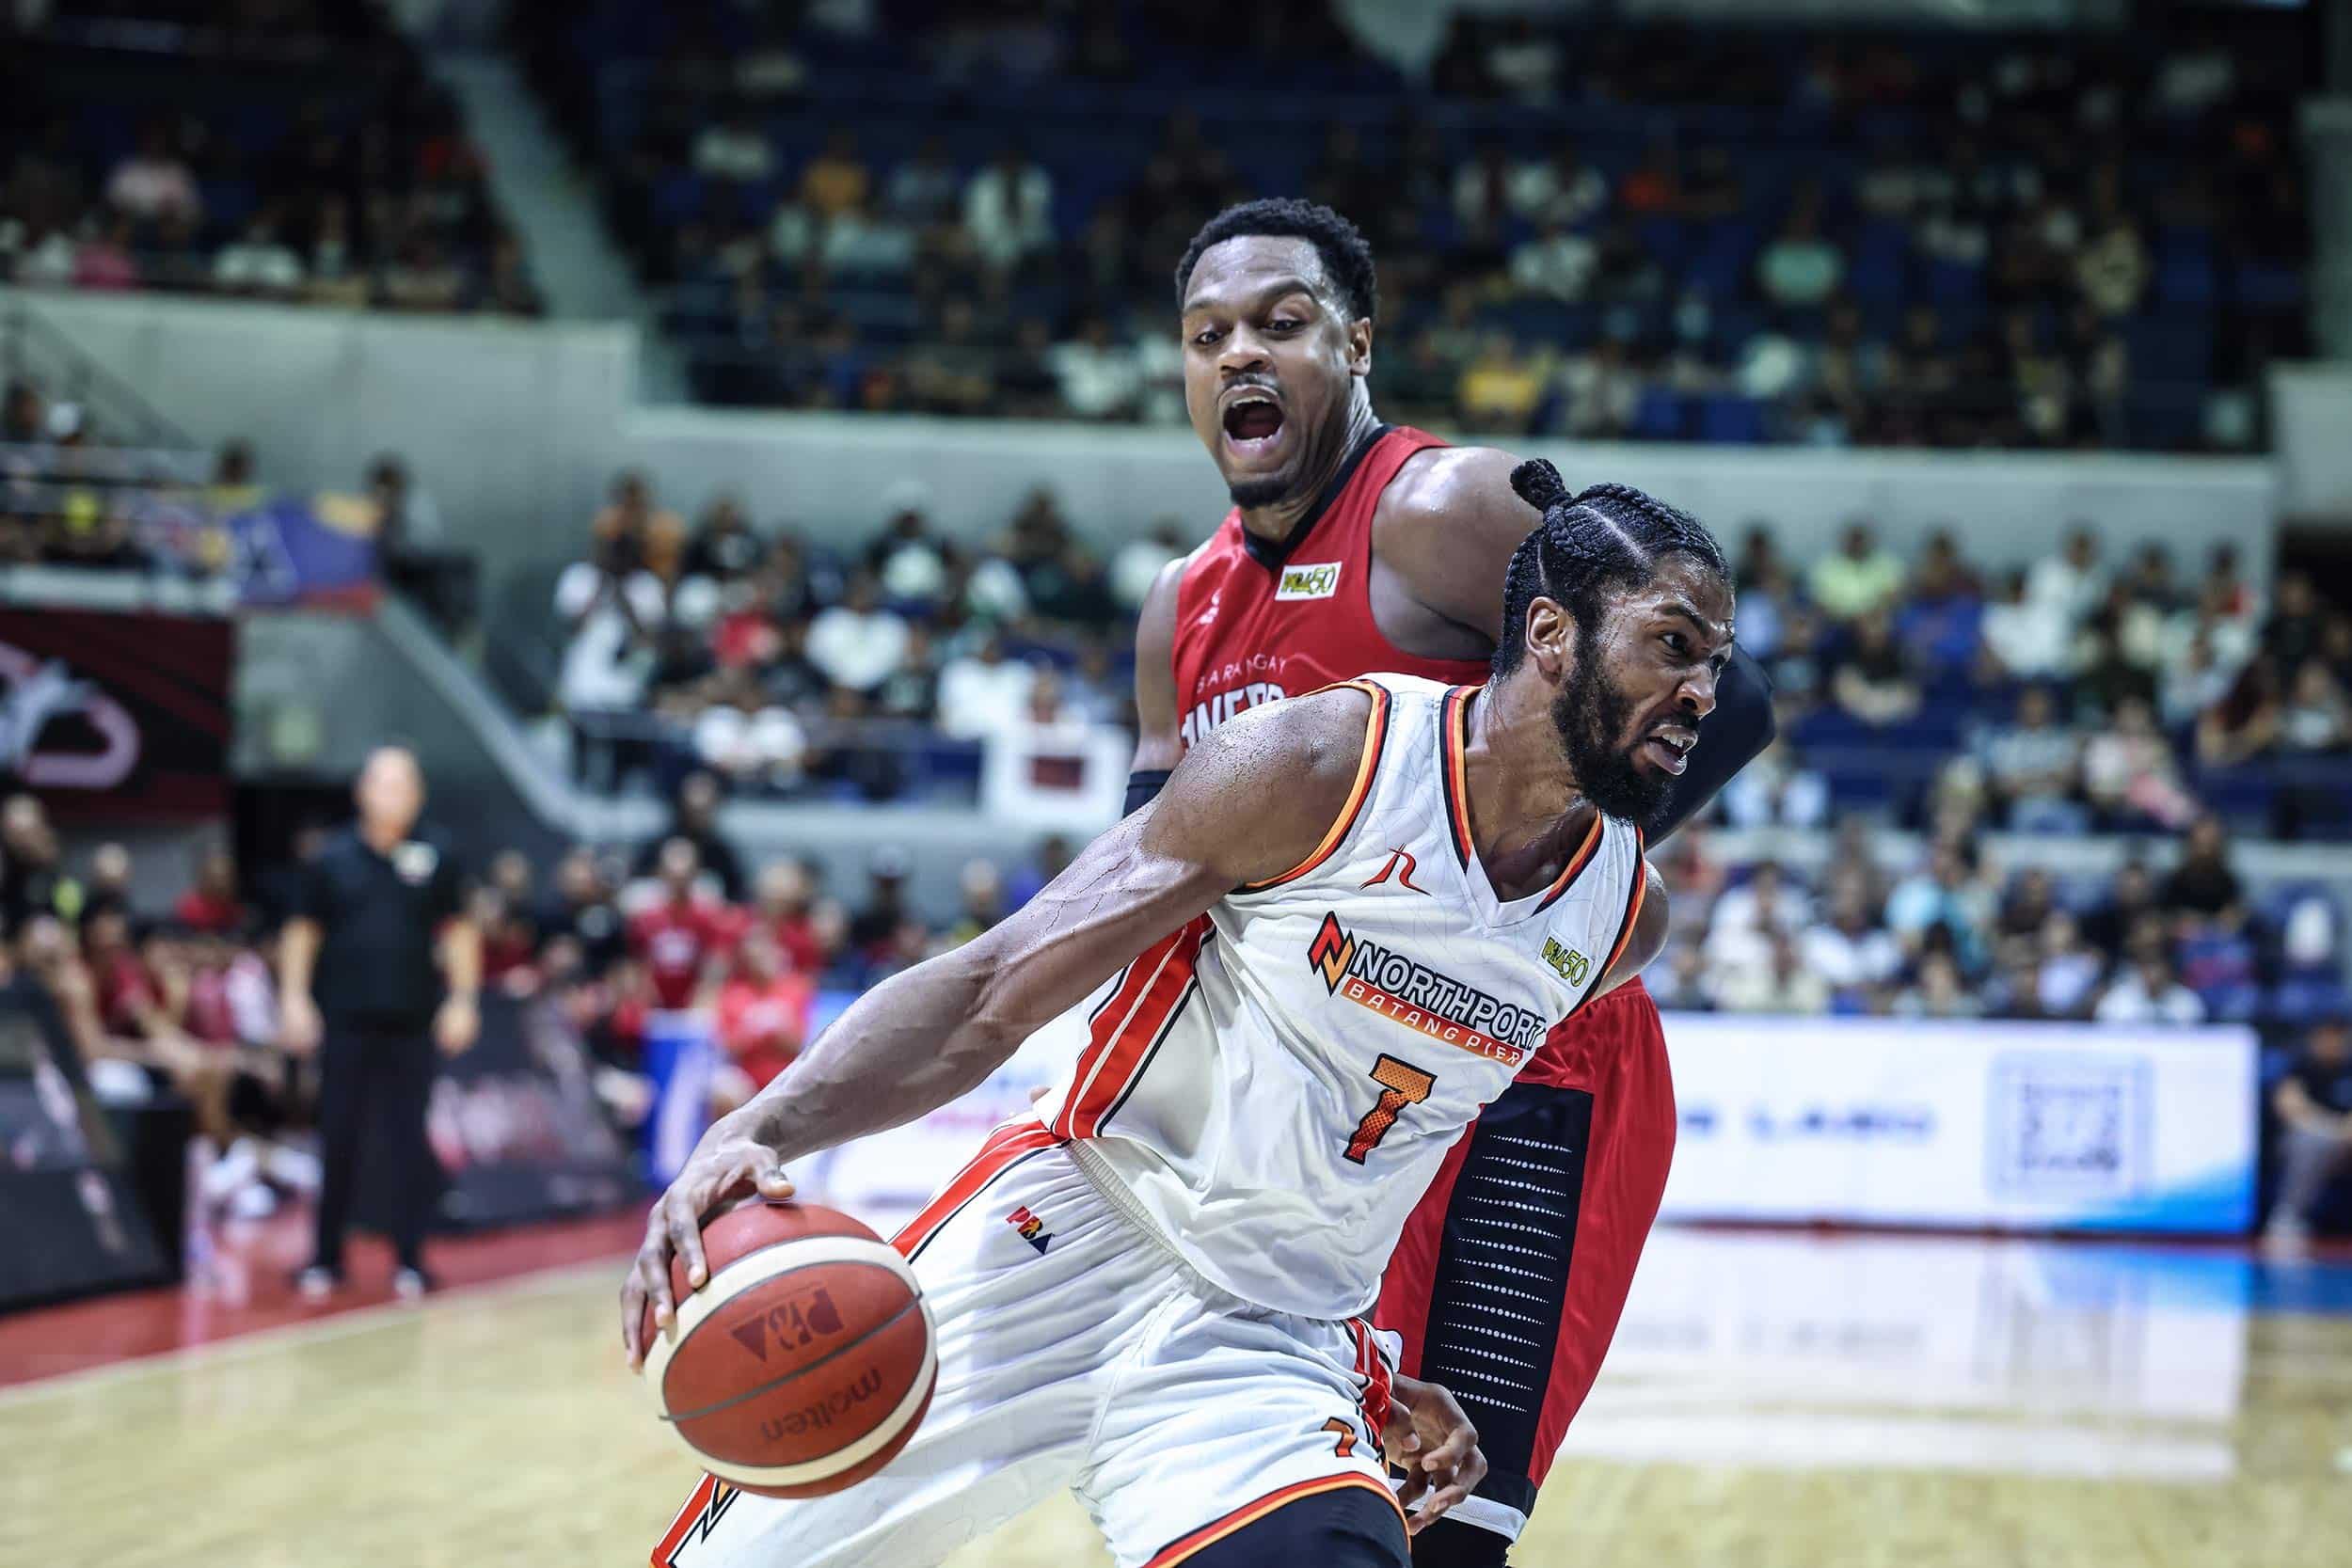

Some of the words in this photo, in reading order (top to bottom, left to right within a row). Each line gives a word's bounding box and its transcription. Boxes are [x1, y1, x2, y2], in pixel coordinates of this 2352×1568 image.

[1348, 939, 1548, 1051] NORTHPORT
[1348, 983, 1460, 1040] BATANG
[1465, 1034, 1520, 1065] PIER
[1343, 1053, 1438, 1165] 7
[760, 1368, 882, 1441] molten
